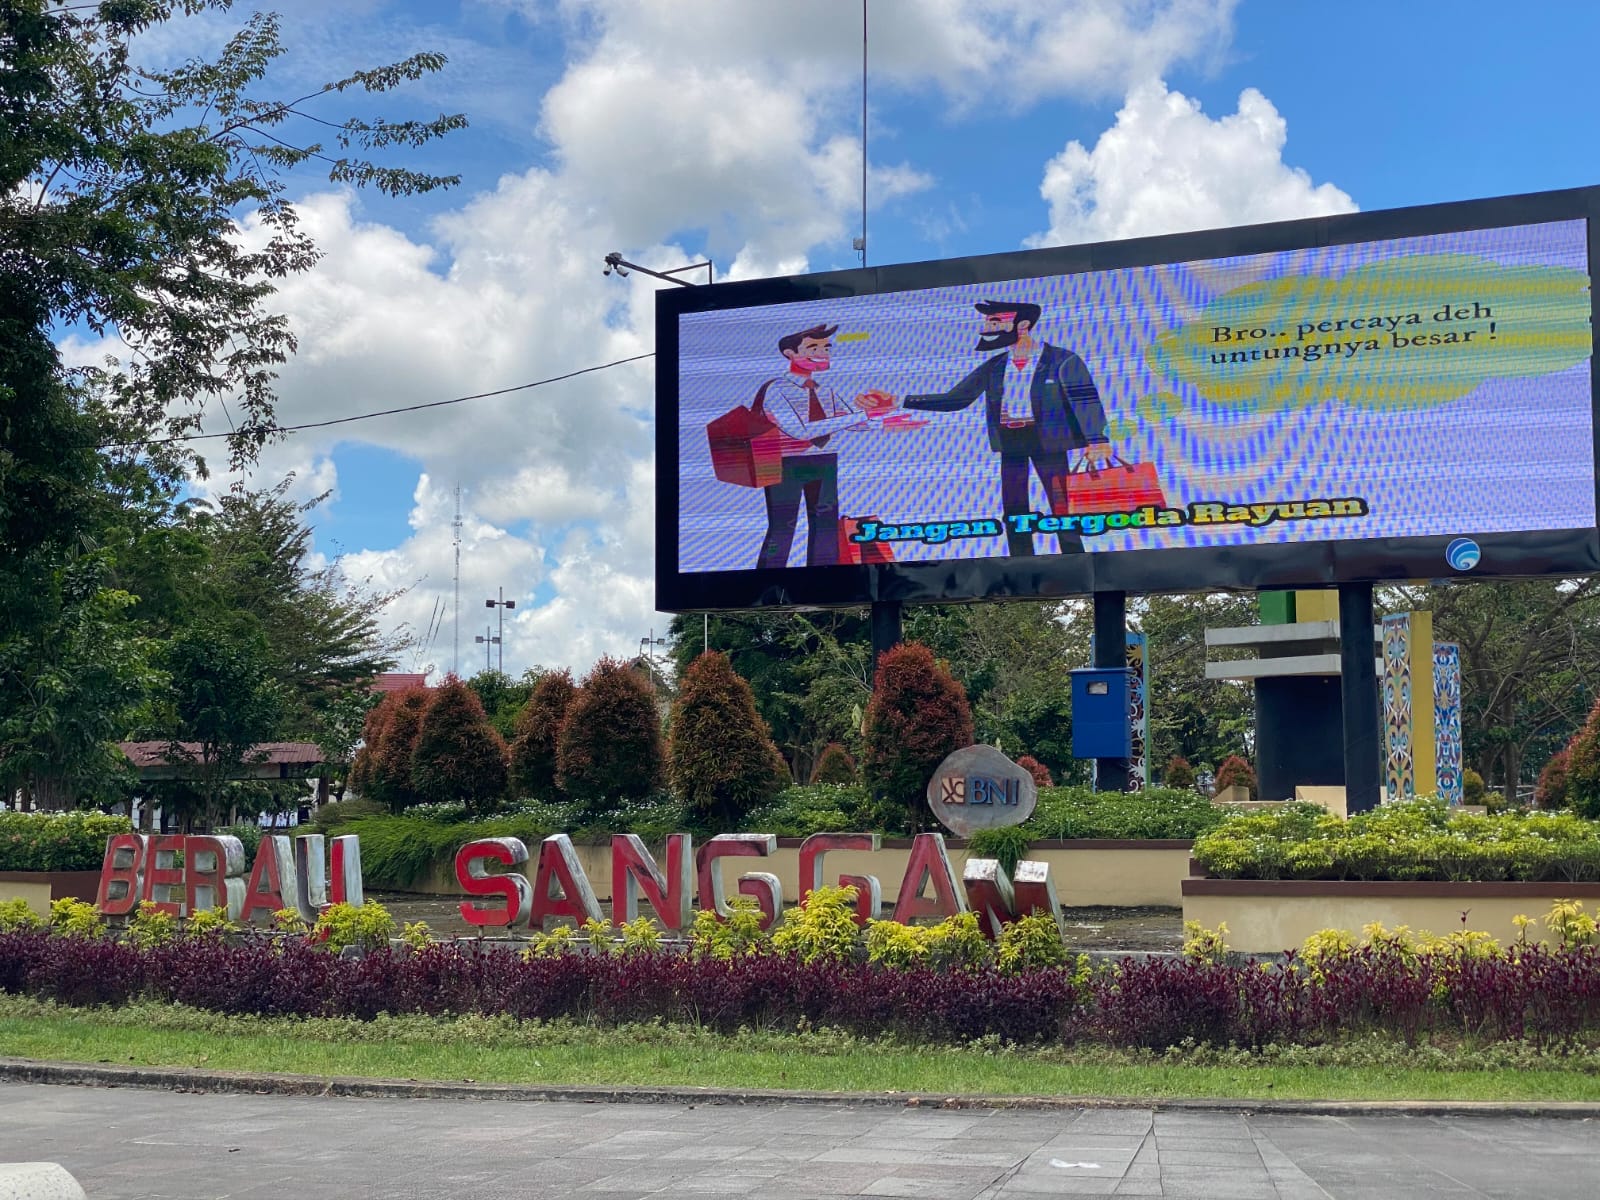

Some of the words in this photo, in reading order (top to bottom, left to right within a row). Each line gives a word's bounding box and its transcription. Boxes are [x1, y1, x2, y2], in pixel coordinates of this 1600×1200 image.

[1210, 325, 1287, 344] Bro..
[1296, 312, 1422, 341] percaya
[1432, 302, 1495, 322] deh
[1210, 339, 1381, 364] untungnya
[1391, 327, 1478, 349] besar
[852, 518, 1001, 544] Jangan
[1006, 506, 1184, 535] Tergoda
[1189, 497, 1366, 527] Rayuan
[969, 776, 1020, 805] BNI
[96, 833, 364, 932] BERAU
